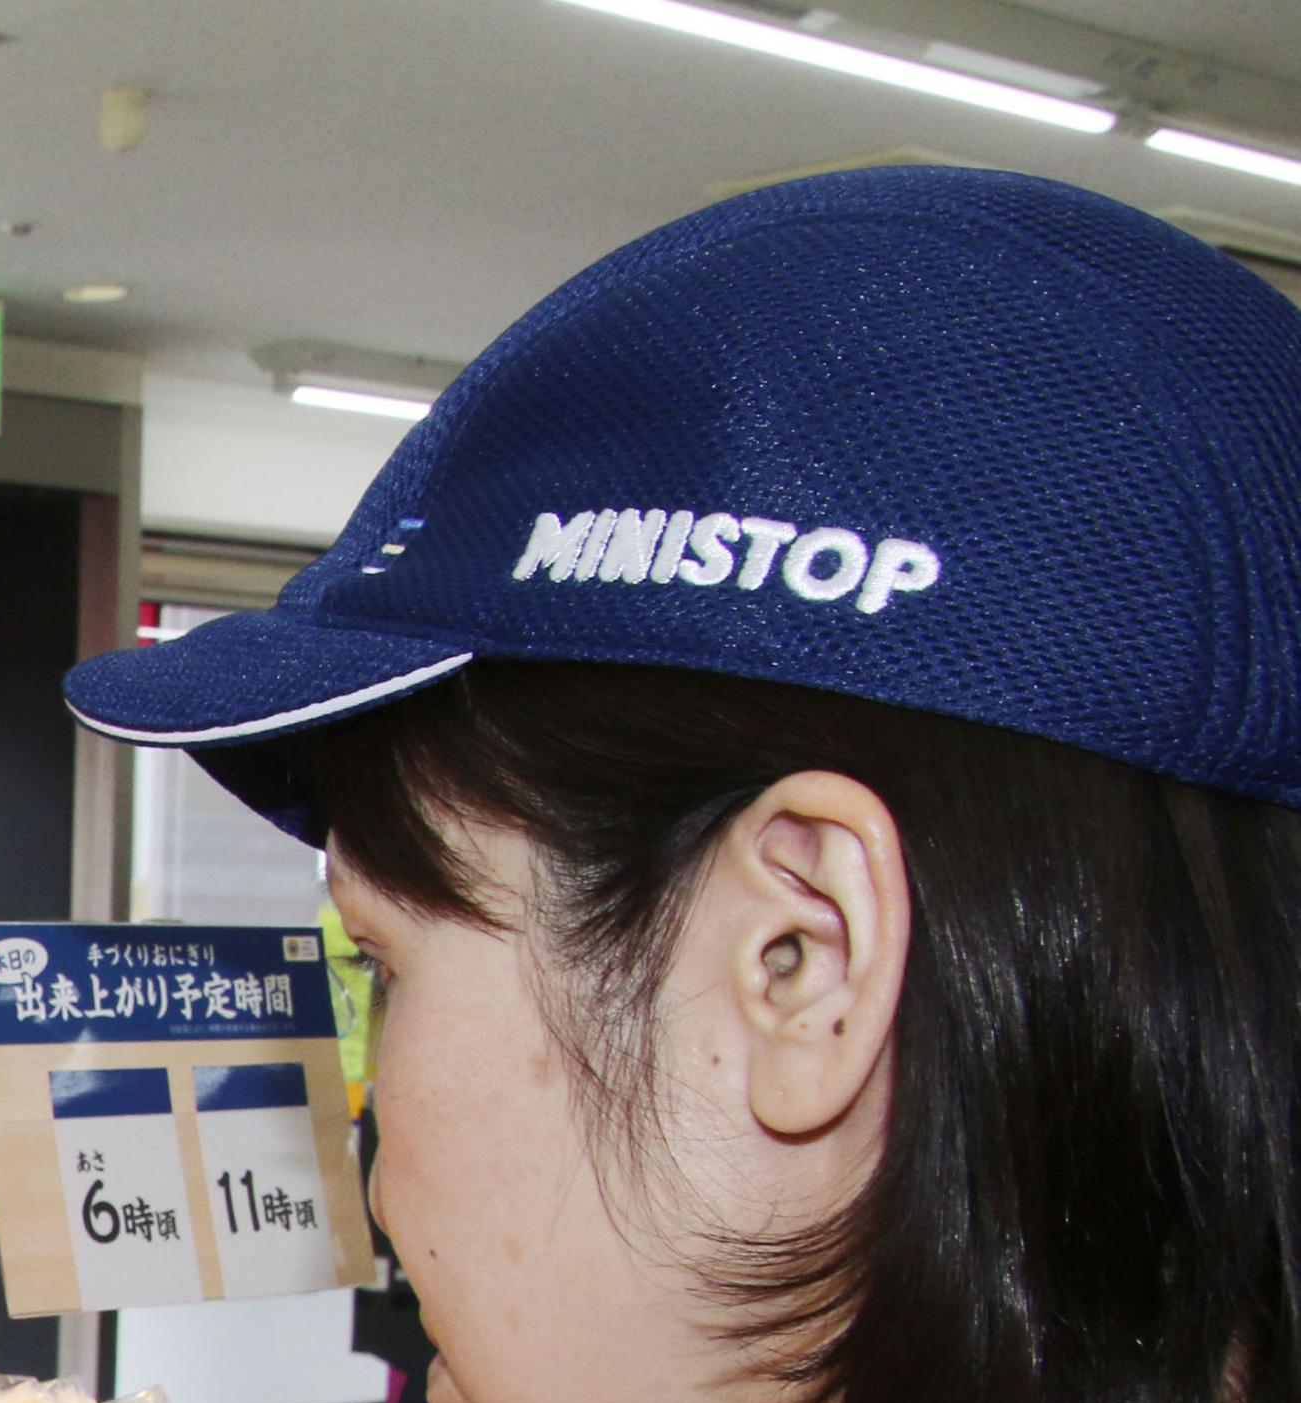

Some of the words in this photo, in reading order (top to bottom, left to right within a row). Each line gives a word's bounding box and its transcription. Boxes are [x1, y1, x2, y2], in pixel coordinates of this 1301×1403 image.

[511, 508, 939, 614] MINISTOP
[87, 943, 215, 968] 手づくりおにぎり
[13, 972, 294, 1022] 出来上がり予定時間
[75, 1150, 105, 1173] あさ
[82, 1179, 180, 1244] 6時頃
[217, 1169, 318, 1235] 11時頃
